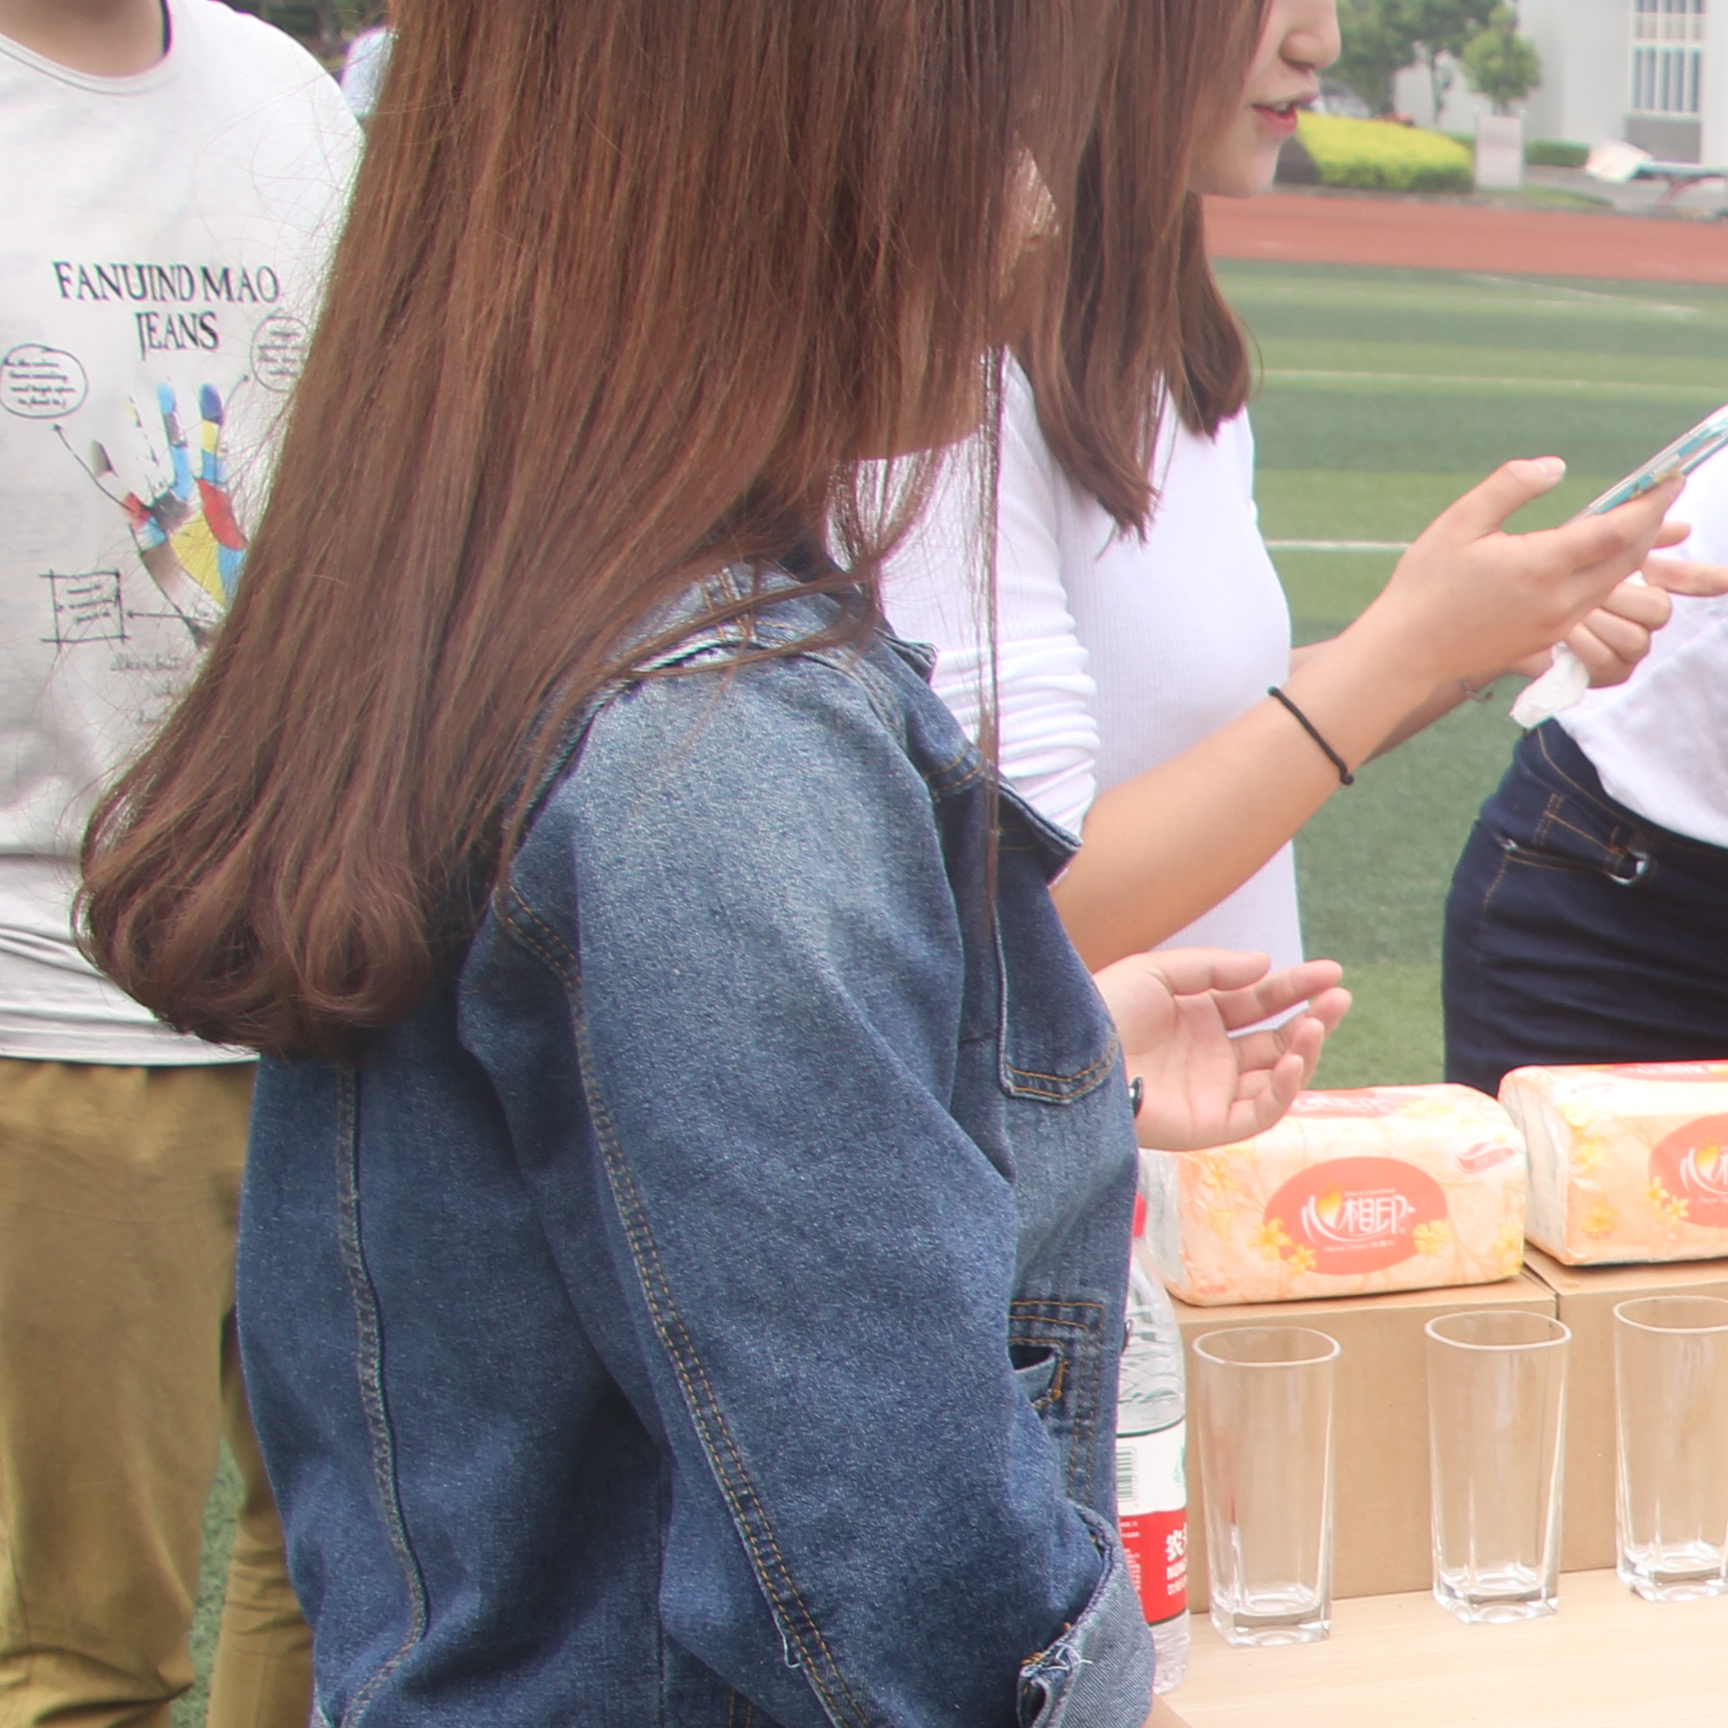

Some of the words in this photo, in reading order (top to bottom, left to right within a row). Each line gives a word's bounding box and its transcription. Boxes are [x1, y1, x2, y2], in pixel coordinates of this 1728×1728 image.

[52, 261, 195, 301] FANUIND
[199, 265, 279, 303] MAO
[135, 310, 219, 361] JEANS
